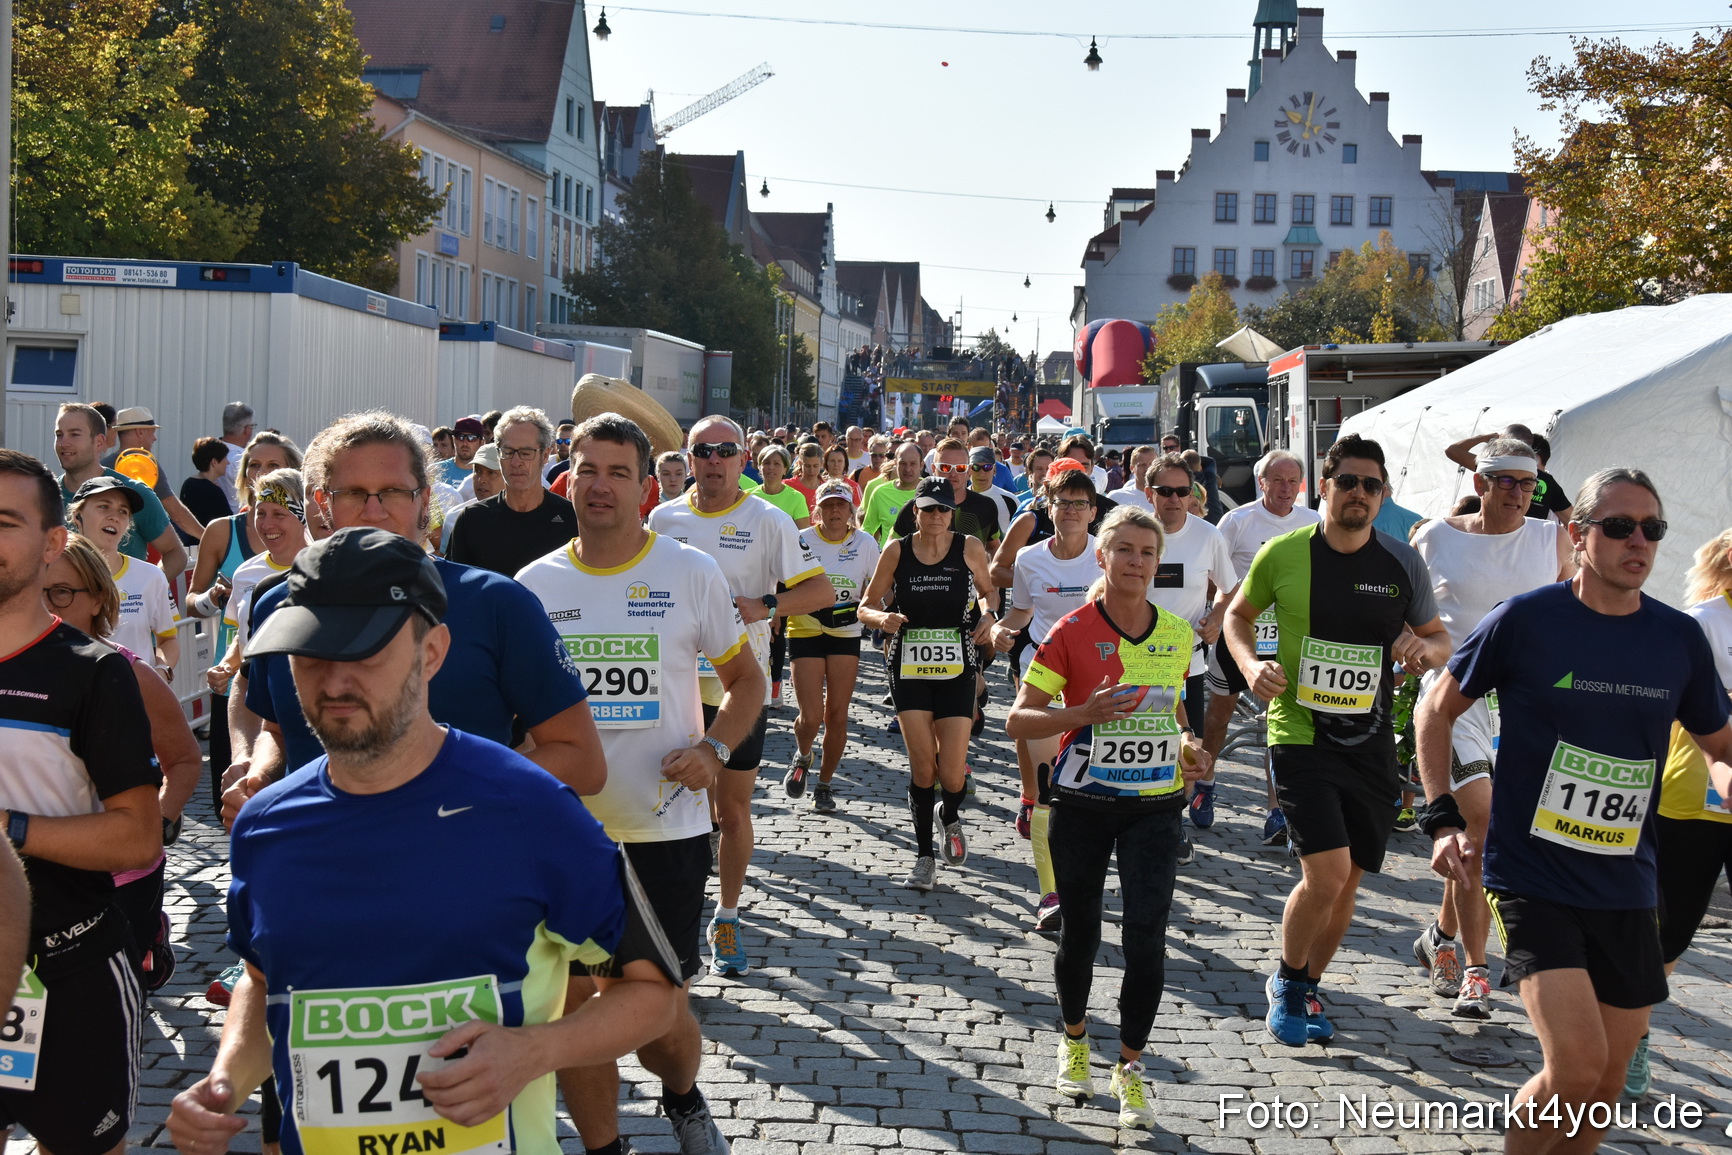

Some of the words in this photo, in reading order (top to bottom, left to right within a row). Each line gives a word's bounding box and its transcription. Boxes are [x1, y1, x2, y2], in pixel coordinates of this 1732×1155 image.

[80, 267, 93, 275] TOI
[100, 268, 115, 276] DIXI
[122, 277, 169, 285] www.toitoidixi.de
[711, 387, 730, 399] BO
[921, 382, 960, 393] START
[721, 525, 736, 536] 20
[719, 542, 746, 551] Stadtlauf
[720, 536, 754, 544] Neumarkter
[628, 586, 648, 599] 20
[911, 584, 950, 592] Regensburg
[1354, 583, 1394, 595] solectrix
[549, 609, 581, 620] BOCK
[627, 609, 666, 618] Stadtlauf
[908, 629, 955, 640] BOCK
[563, 638, 646, 657] BOCK
[909, 645, 956, 662] 1035
[1308, 642, 1374, 664] BOCK
[917, 666, 948, 674] PETRA
[578, 667, 649, 696] 290
[1309, 664, 1371, 691] 1109
[7, 689, 49, 700] ILLSCHWANG
[1573, 679, 1613, 694] GOSSEN
[1615, 684, 1670, 700] METRAWATT
[1313, 692, 1357, 706] ROMAN
[1101, 717, 1172, 733] BOCK
[1101, 740, 1168, 764] 2691
[1562, 750, 1648, 786] BOCK
[1559, 782, 1638, 822] 1184
[1554, 819, 1625, 844] MARKUS
[306, 987, 472, 1038] BOCK
[316, 1047, 469, 1115] 124
[358, 1127, 446, 1155] RYAN
